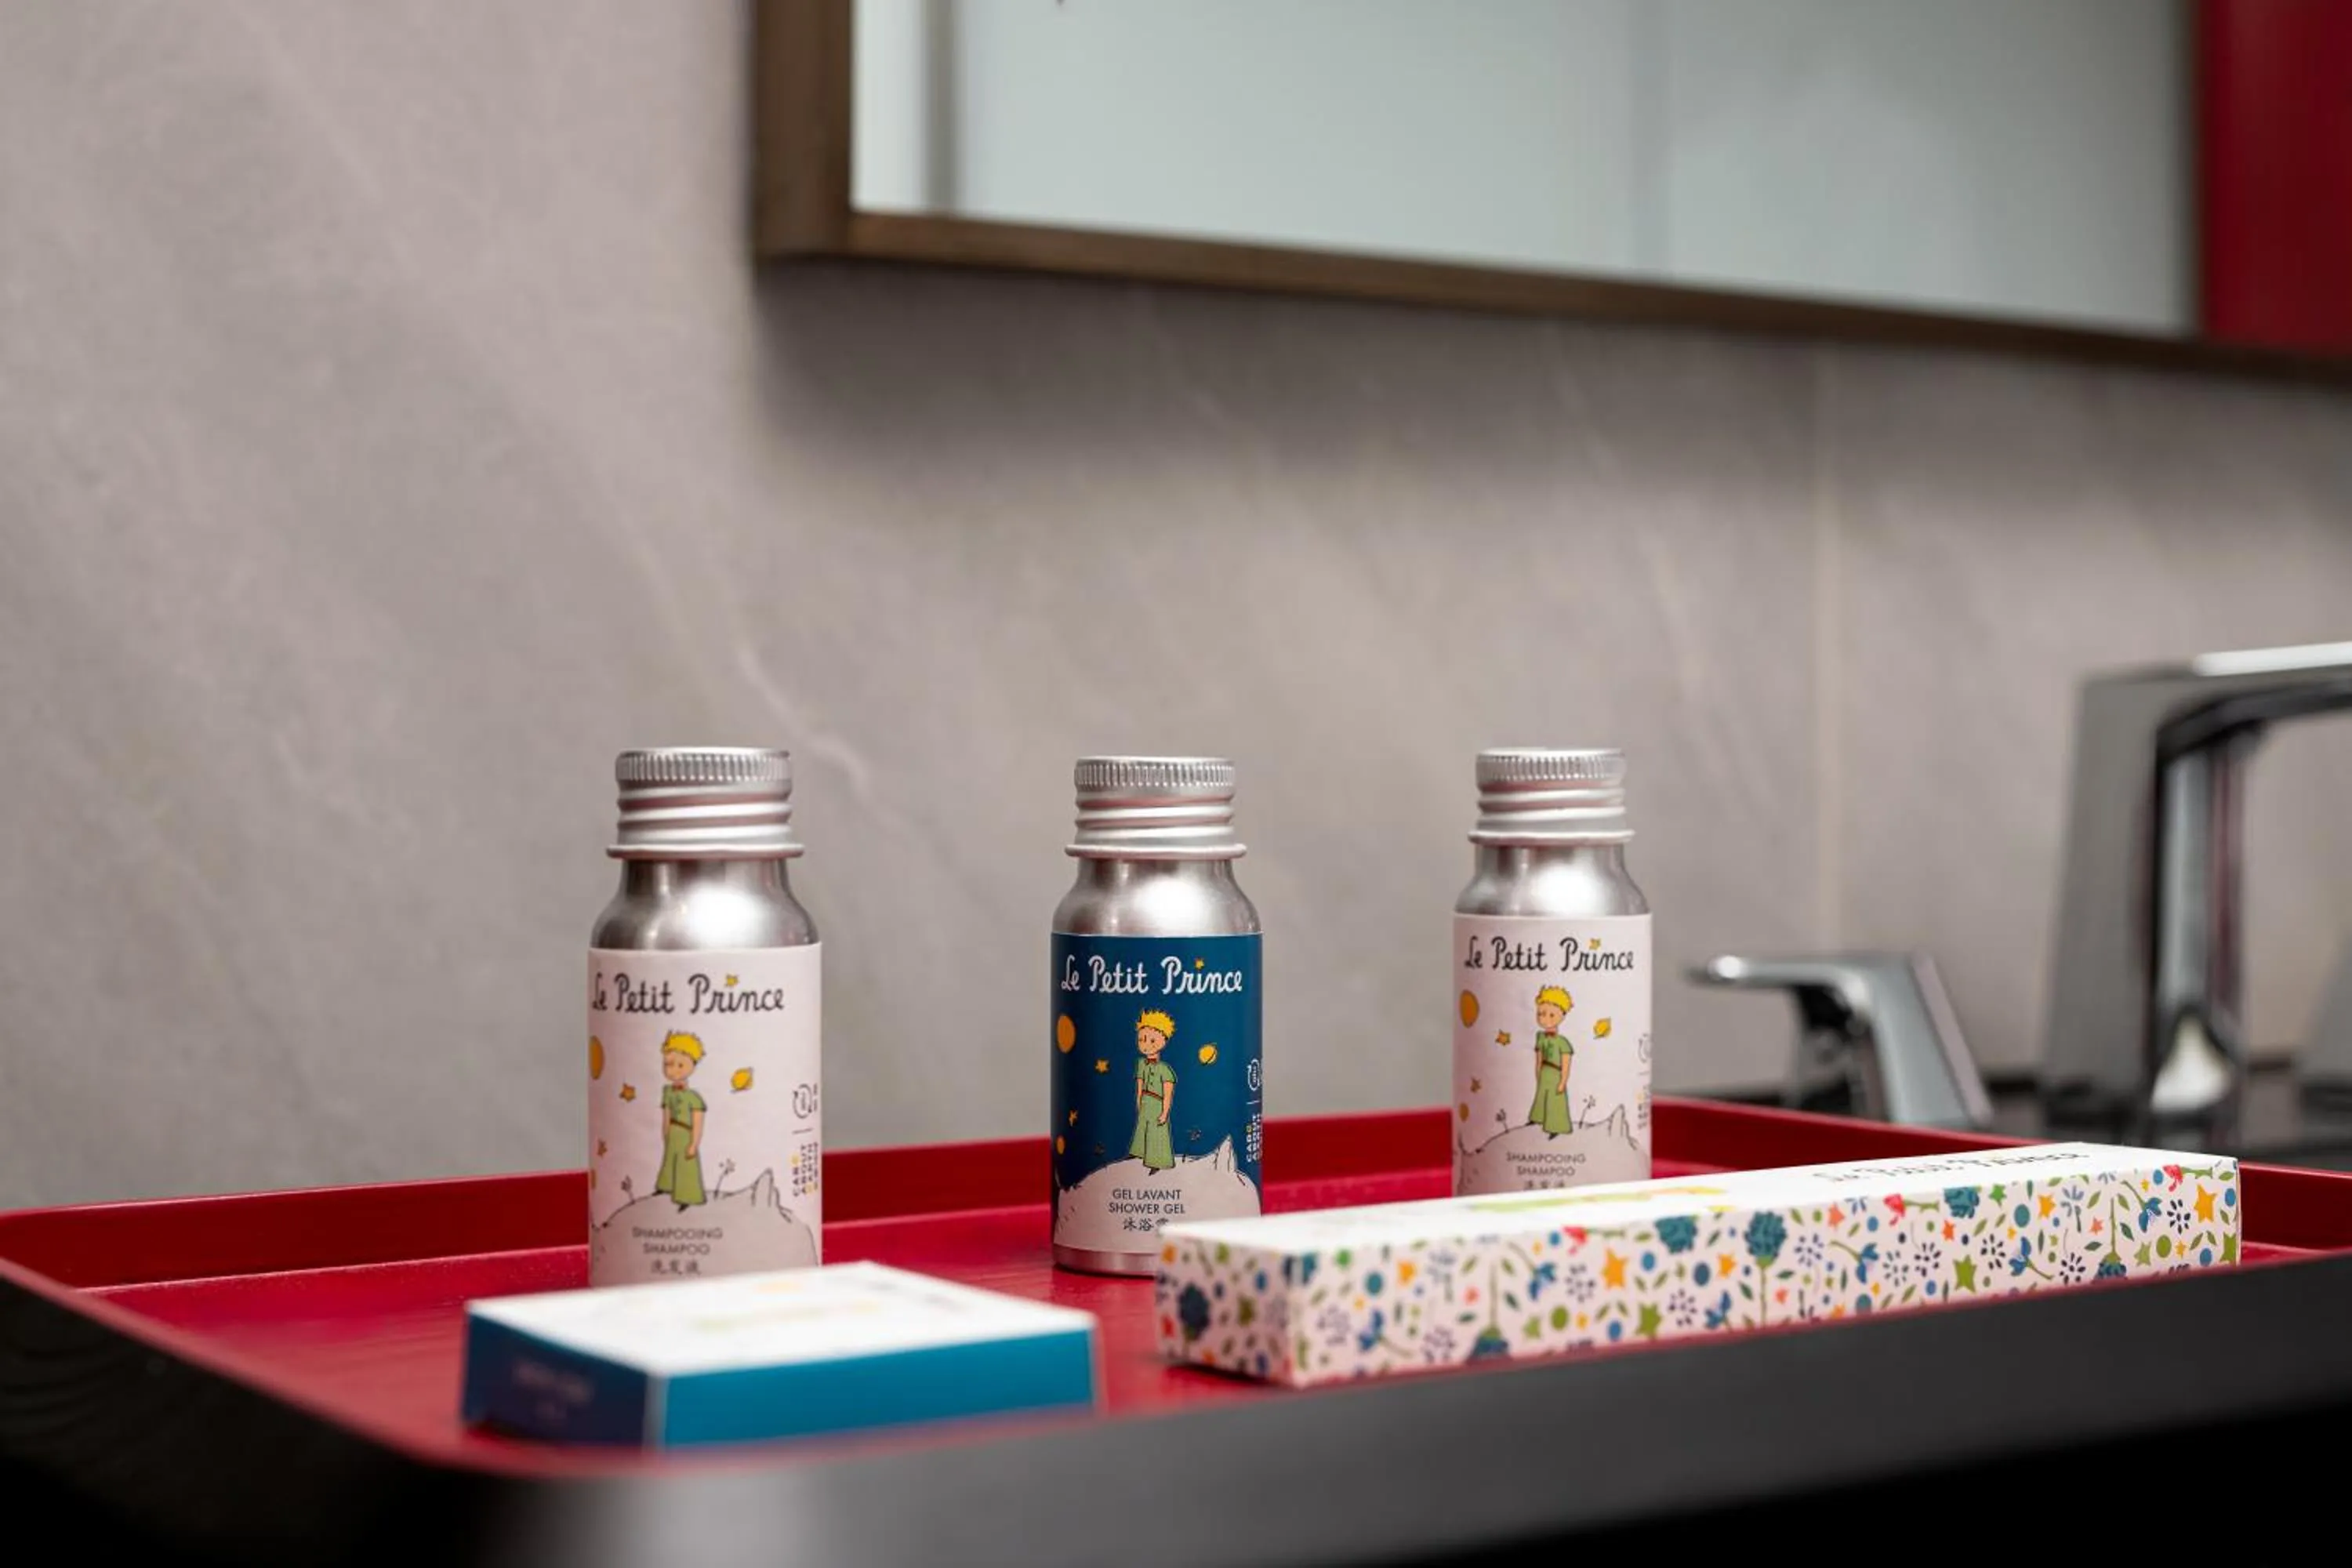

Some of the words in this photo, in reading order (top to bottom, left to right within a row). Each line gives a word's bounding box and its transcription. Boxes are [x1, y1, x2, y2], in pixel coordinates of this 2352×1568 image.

[1465, 935, 1483, 969] Le
[1491, 936, 1548, 971] Petit
[1560, 937, 1634, 971] Prince
[1061, 954, 1080, 992] Le
[1088, 955, 1149, 994] Petit
[1160, 955, 1243, 994] Prince
[592, 972, 608, 1011] Le
[614, 972, 675, 1014] Petit
[688, 973, 785, 1014] Prince
[1506, 1151, 1586, 1164] SHAMPOOING
[1517, 1166, 1576, 1176] SHAMPOO
[1112, 1189, 1133, 1200] GEL
[1137, 1189, 1181, 1200] LAVANT
[1109, 1202, 1160, 1214] SHOWER
[1163, 1203, 1185, 1214] GEL
[632, 1227, 723, 1239] SHAMPOOING
[643, 1243, 710, 1254] SHAMPOO
